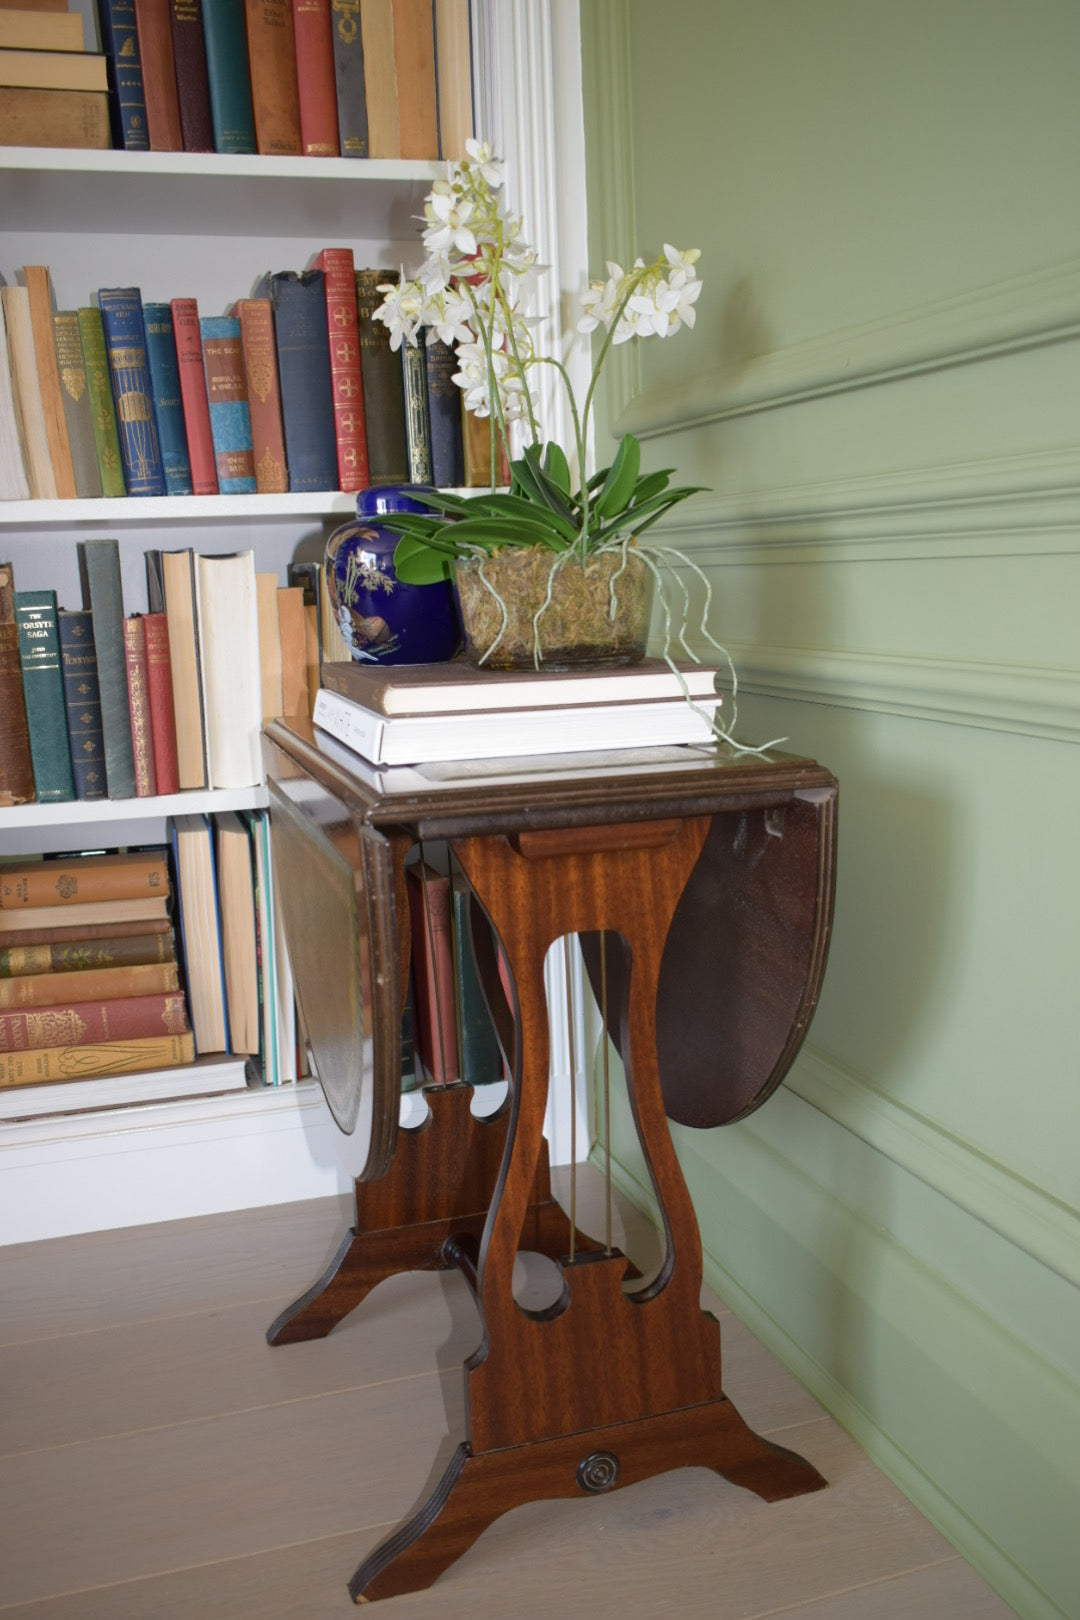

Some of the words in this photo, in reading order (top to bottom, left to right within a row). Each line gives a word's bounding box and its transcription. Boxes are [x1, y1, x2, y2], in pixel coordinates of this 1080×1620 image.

[19, 621, 54, 631] FORSYTE
[27, 630, 49, 639] SAGA
[11, 1016, 24, 1048] DOONE
